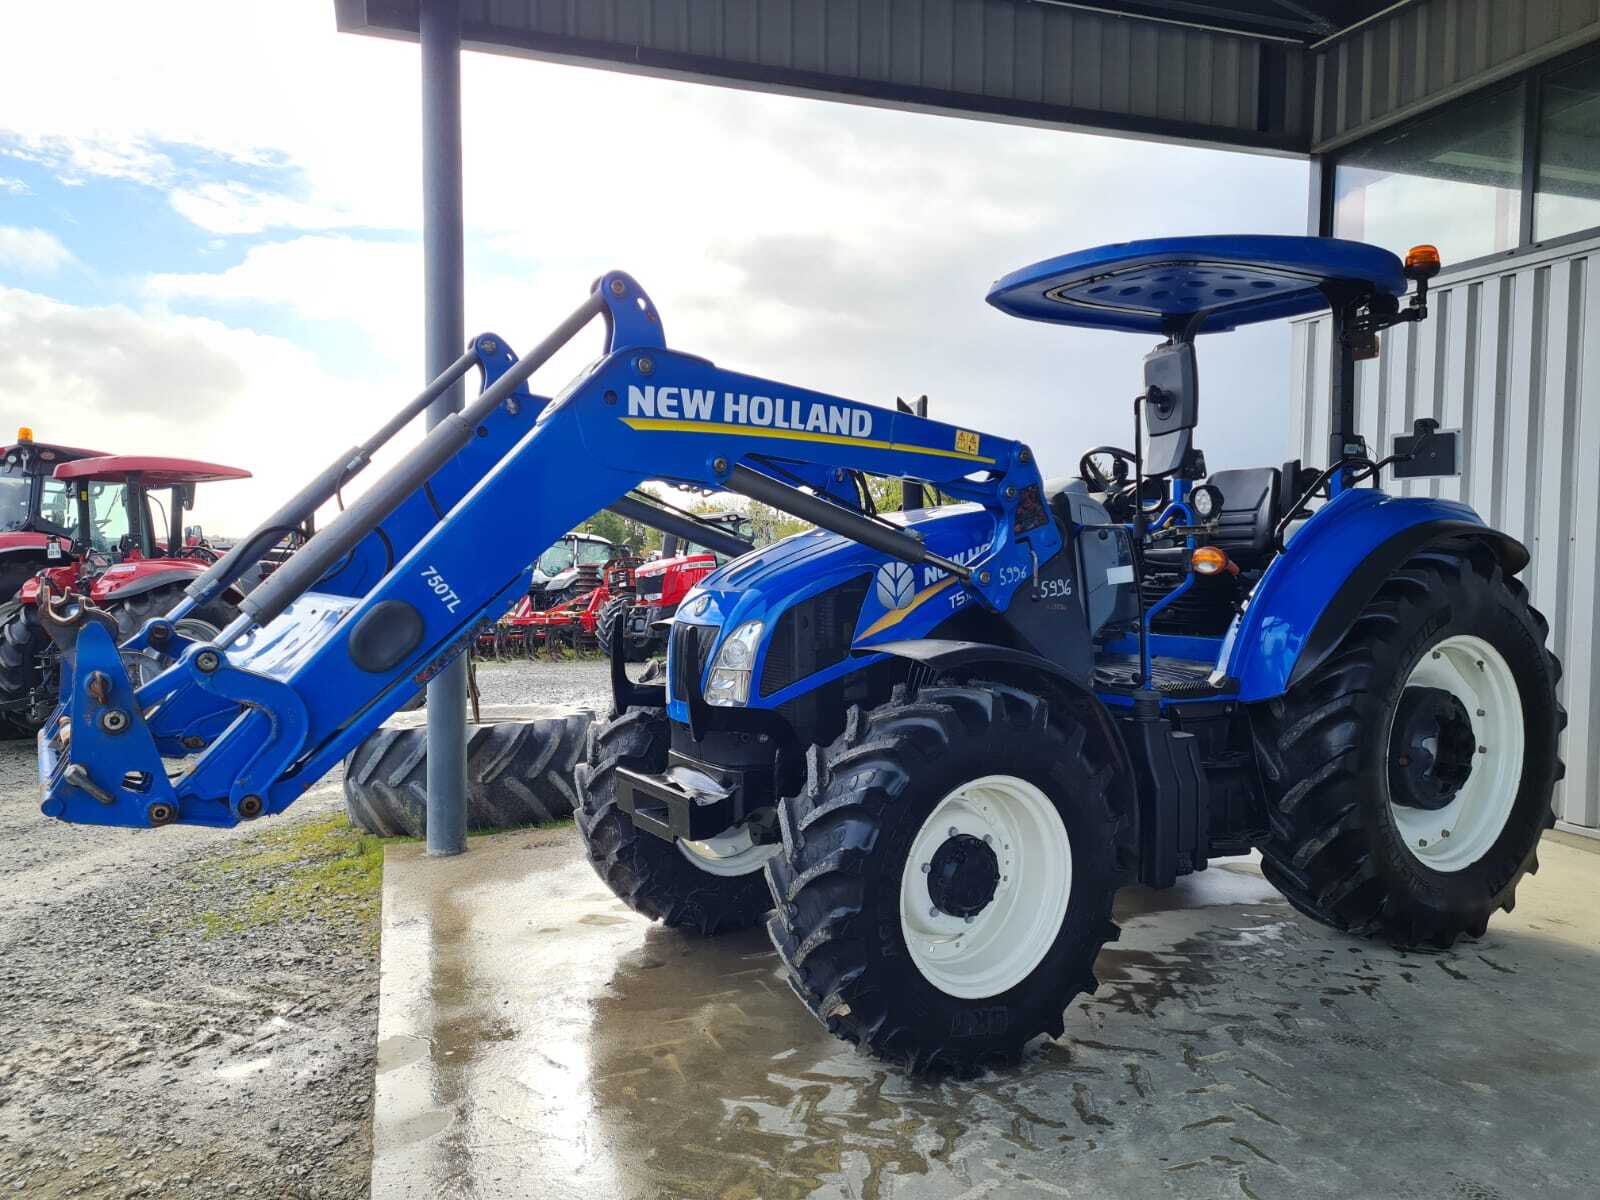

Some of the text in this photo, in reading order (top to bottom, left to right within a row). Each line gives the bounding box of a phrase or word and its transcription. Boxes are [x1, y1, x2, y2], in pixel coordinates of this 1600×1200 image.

[628, 385, 873, 437] NEW HOLLAND
[421, 566, 461, 613] 750TL
[1000, 565, 1027, 586] 5996
[1040, 578, 1071, 598] 5996
